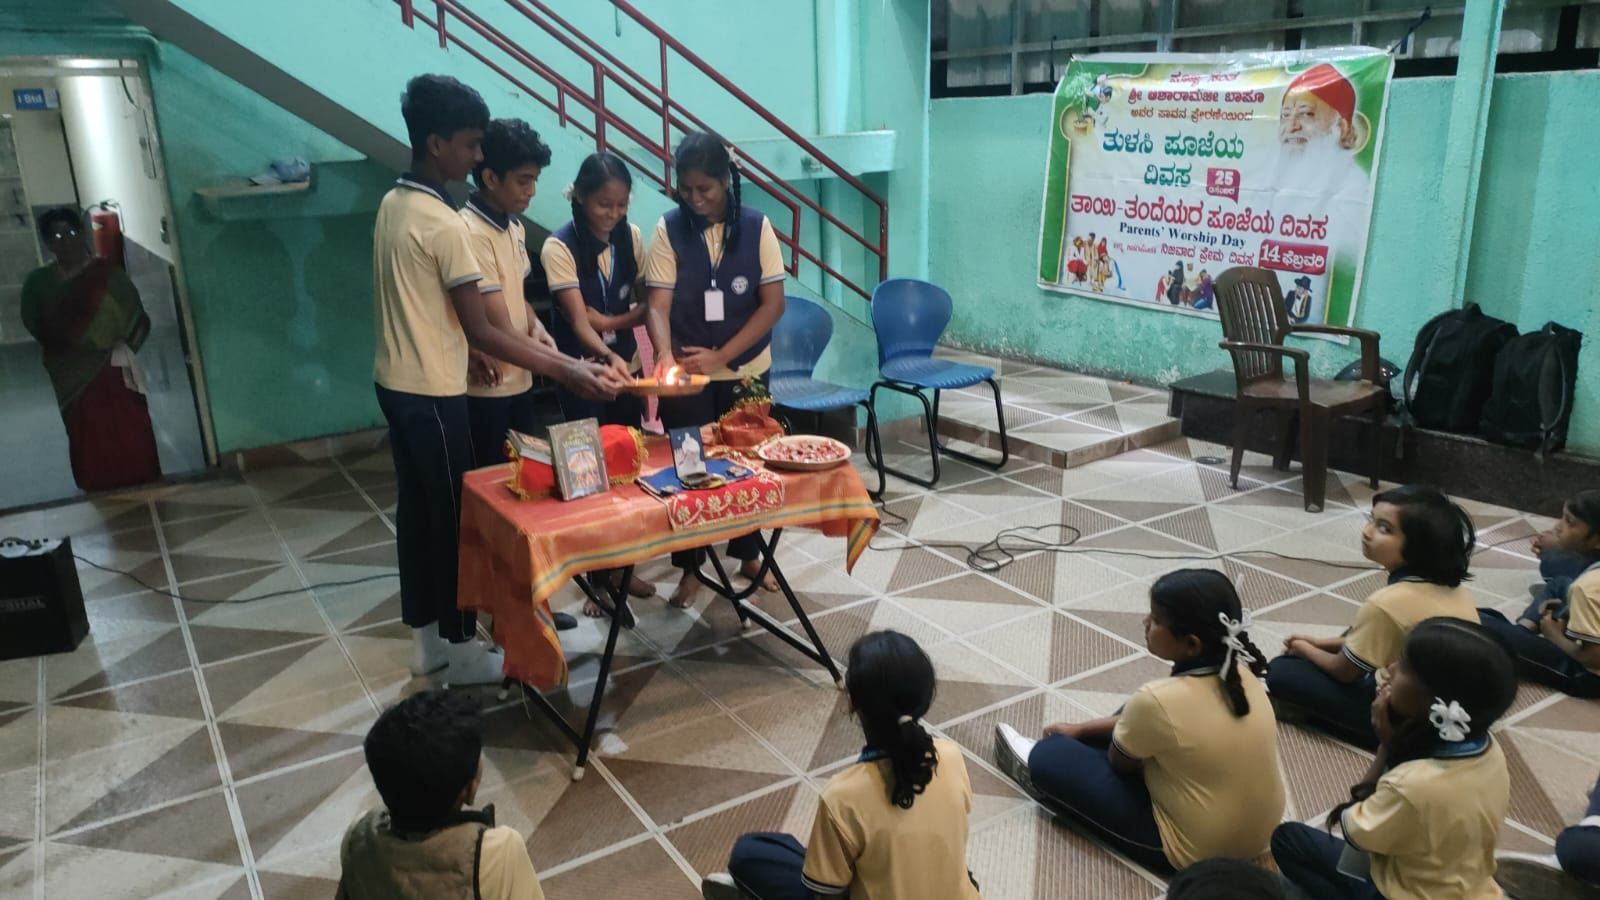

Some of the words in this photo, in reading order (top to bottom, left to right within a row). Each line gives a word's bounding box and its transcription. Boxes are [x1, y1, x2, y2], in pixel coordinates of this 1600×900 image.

[1103, 128, 1154, 153] ತುಳಸಿ
[1164, 130, 1244, 159] ಪೂಜೆಯ
[1144, 162, 1192, 187] ದಿವಸ
[1214, 170, 1234, 185] 25
[1207, 205, 1274, 234] ಪೂಜೆಯ
[1280, 213, 1329, 240] ದಿವಸ
[1168, 227, 1218, 246] Worship
[1222, 234, 1246, 249] Day
[1229, 250, 1255, 266] ದಿವಸ
[1261, 244, 1281, 263] 14
